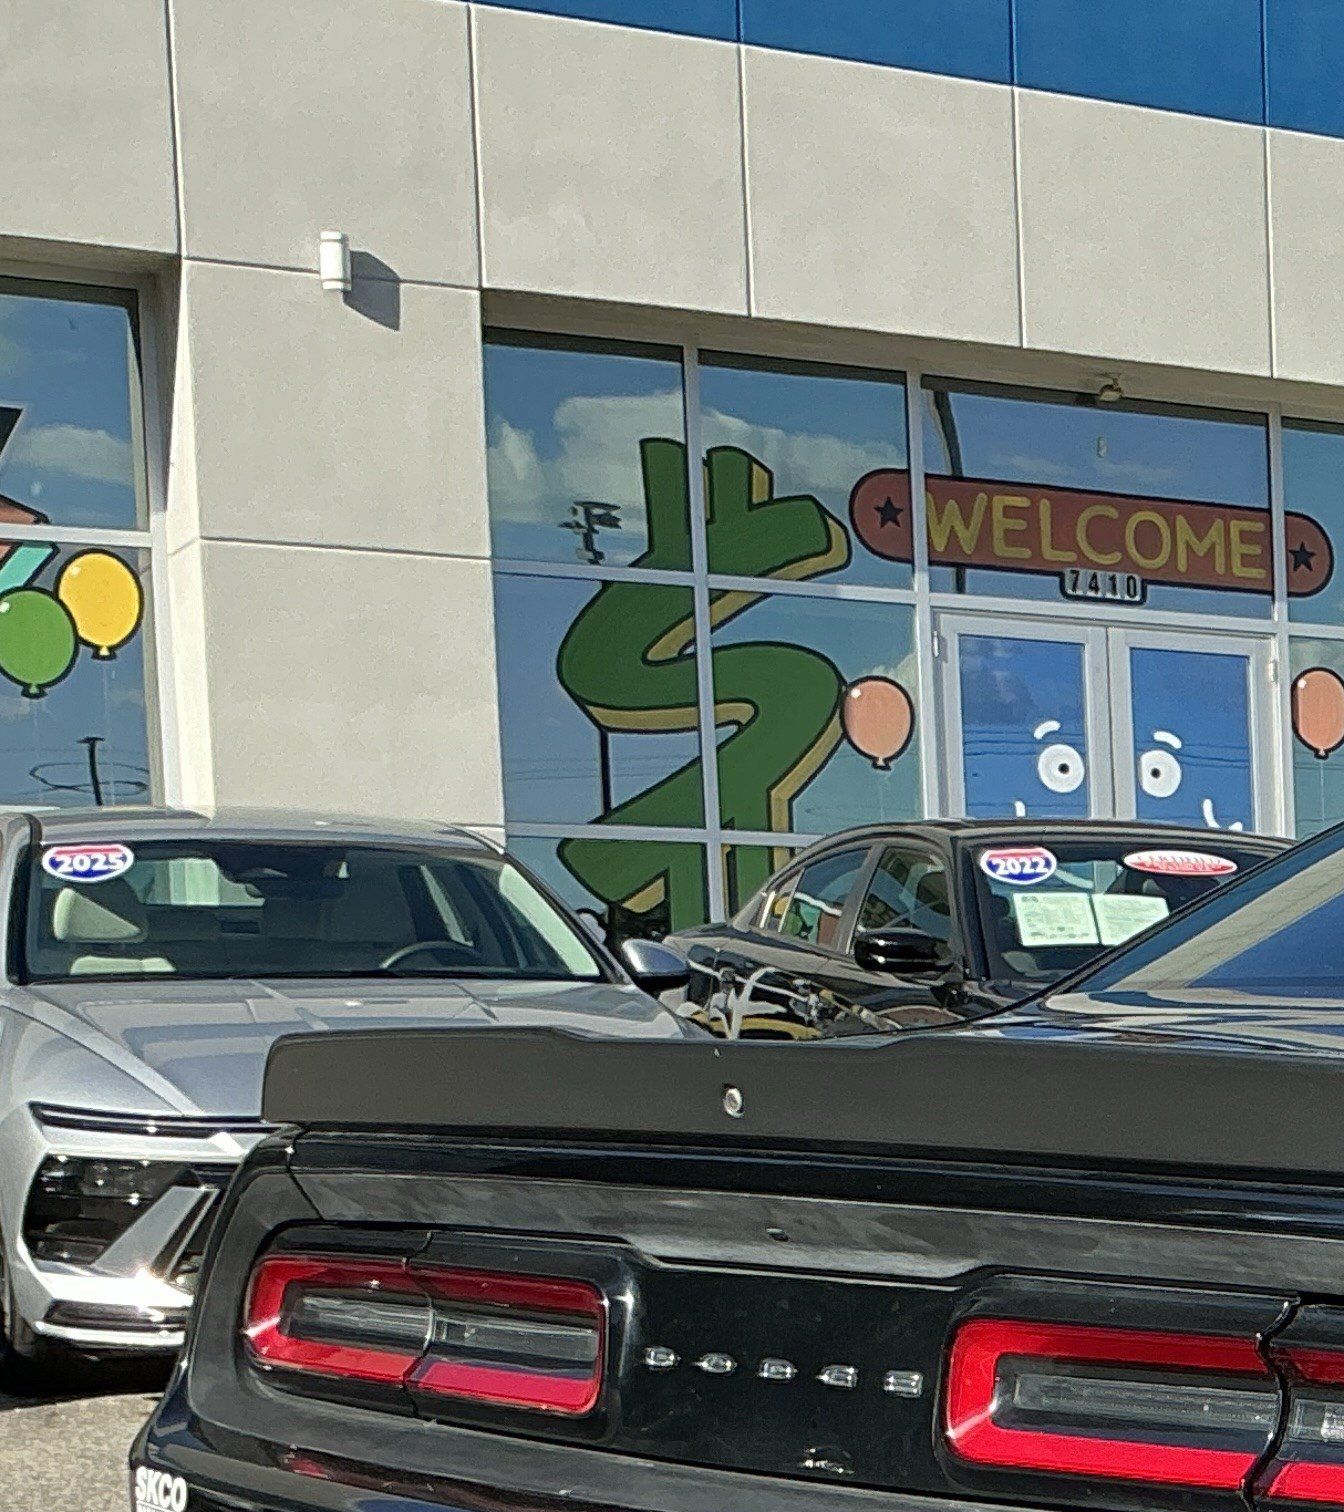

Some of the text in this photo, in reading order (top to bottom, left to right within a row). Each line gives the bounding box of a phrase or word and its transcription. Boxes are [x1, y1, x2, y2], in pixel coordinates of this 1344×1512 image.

[926, 491, 1267, 579] WELCOME
[1067, 568, 1138, 599] 7410
[55, 853, 125, 872] 2025
[992, 855, 1049, 876] 2022
[135, 1466, 188, 1512] SKCO
